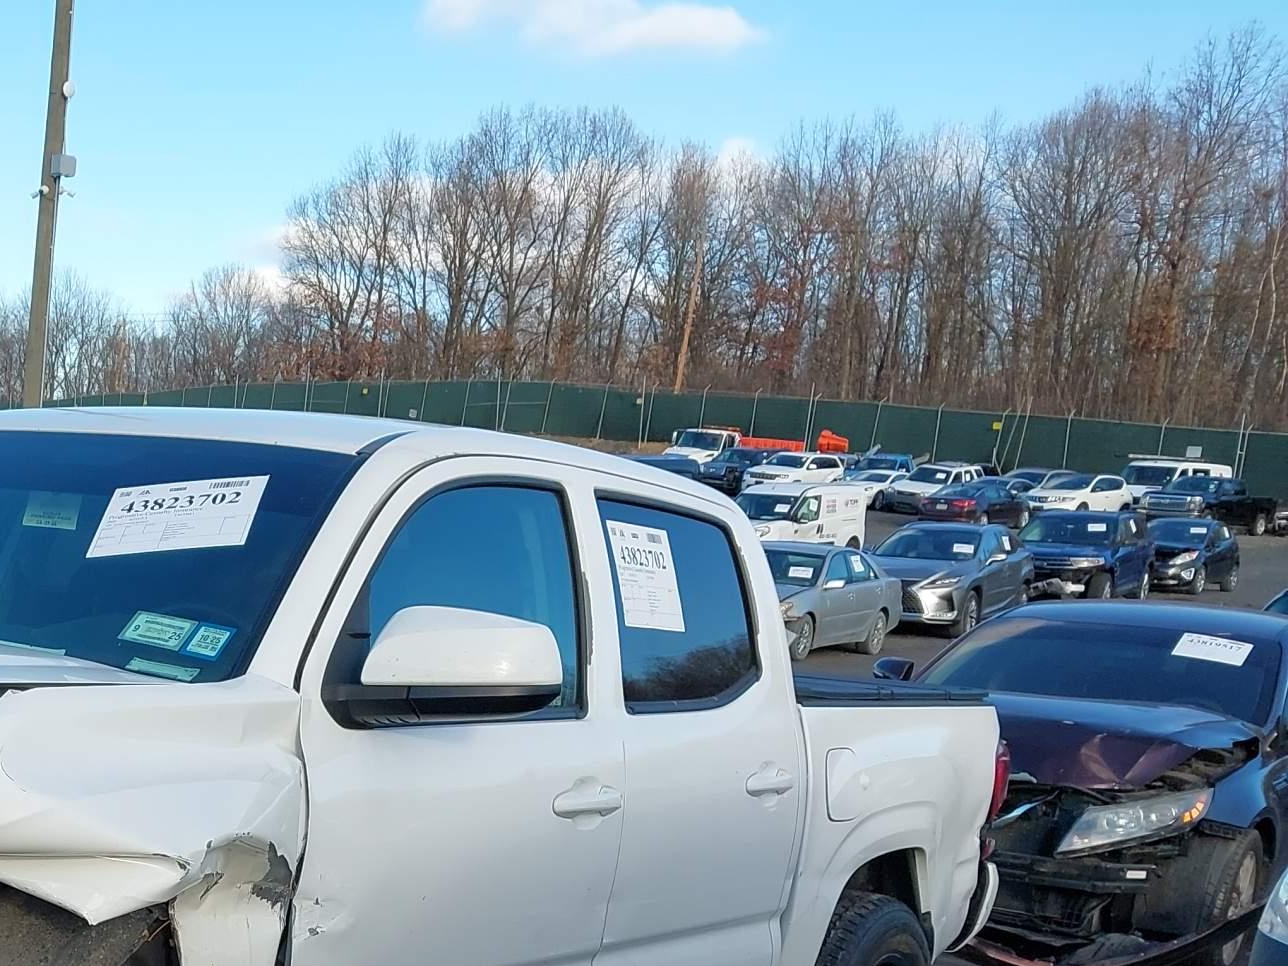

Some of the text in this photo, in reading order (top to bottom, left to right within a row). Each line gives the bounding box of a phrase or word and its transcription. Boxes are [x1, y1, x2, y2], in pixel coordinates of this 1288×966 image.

[120, 491, 242, 514] 43823702
[620, 545, 667, 570] 43823702
[132, 624, 141, 632] 9
[168, 631, 183, 641] 25
